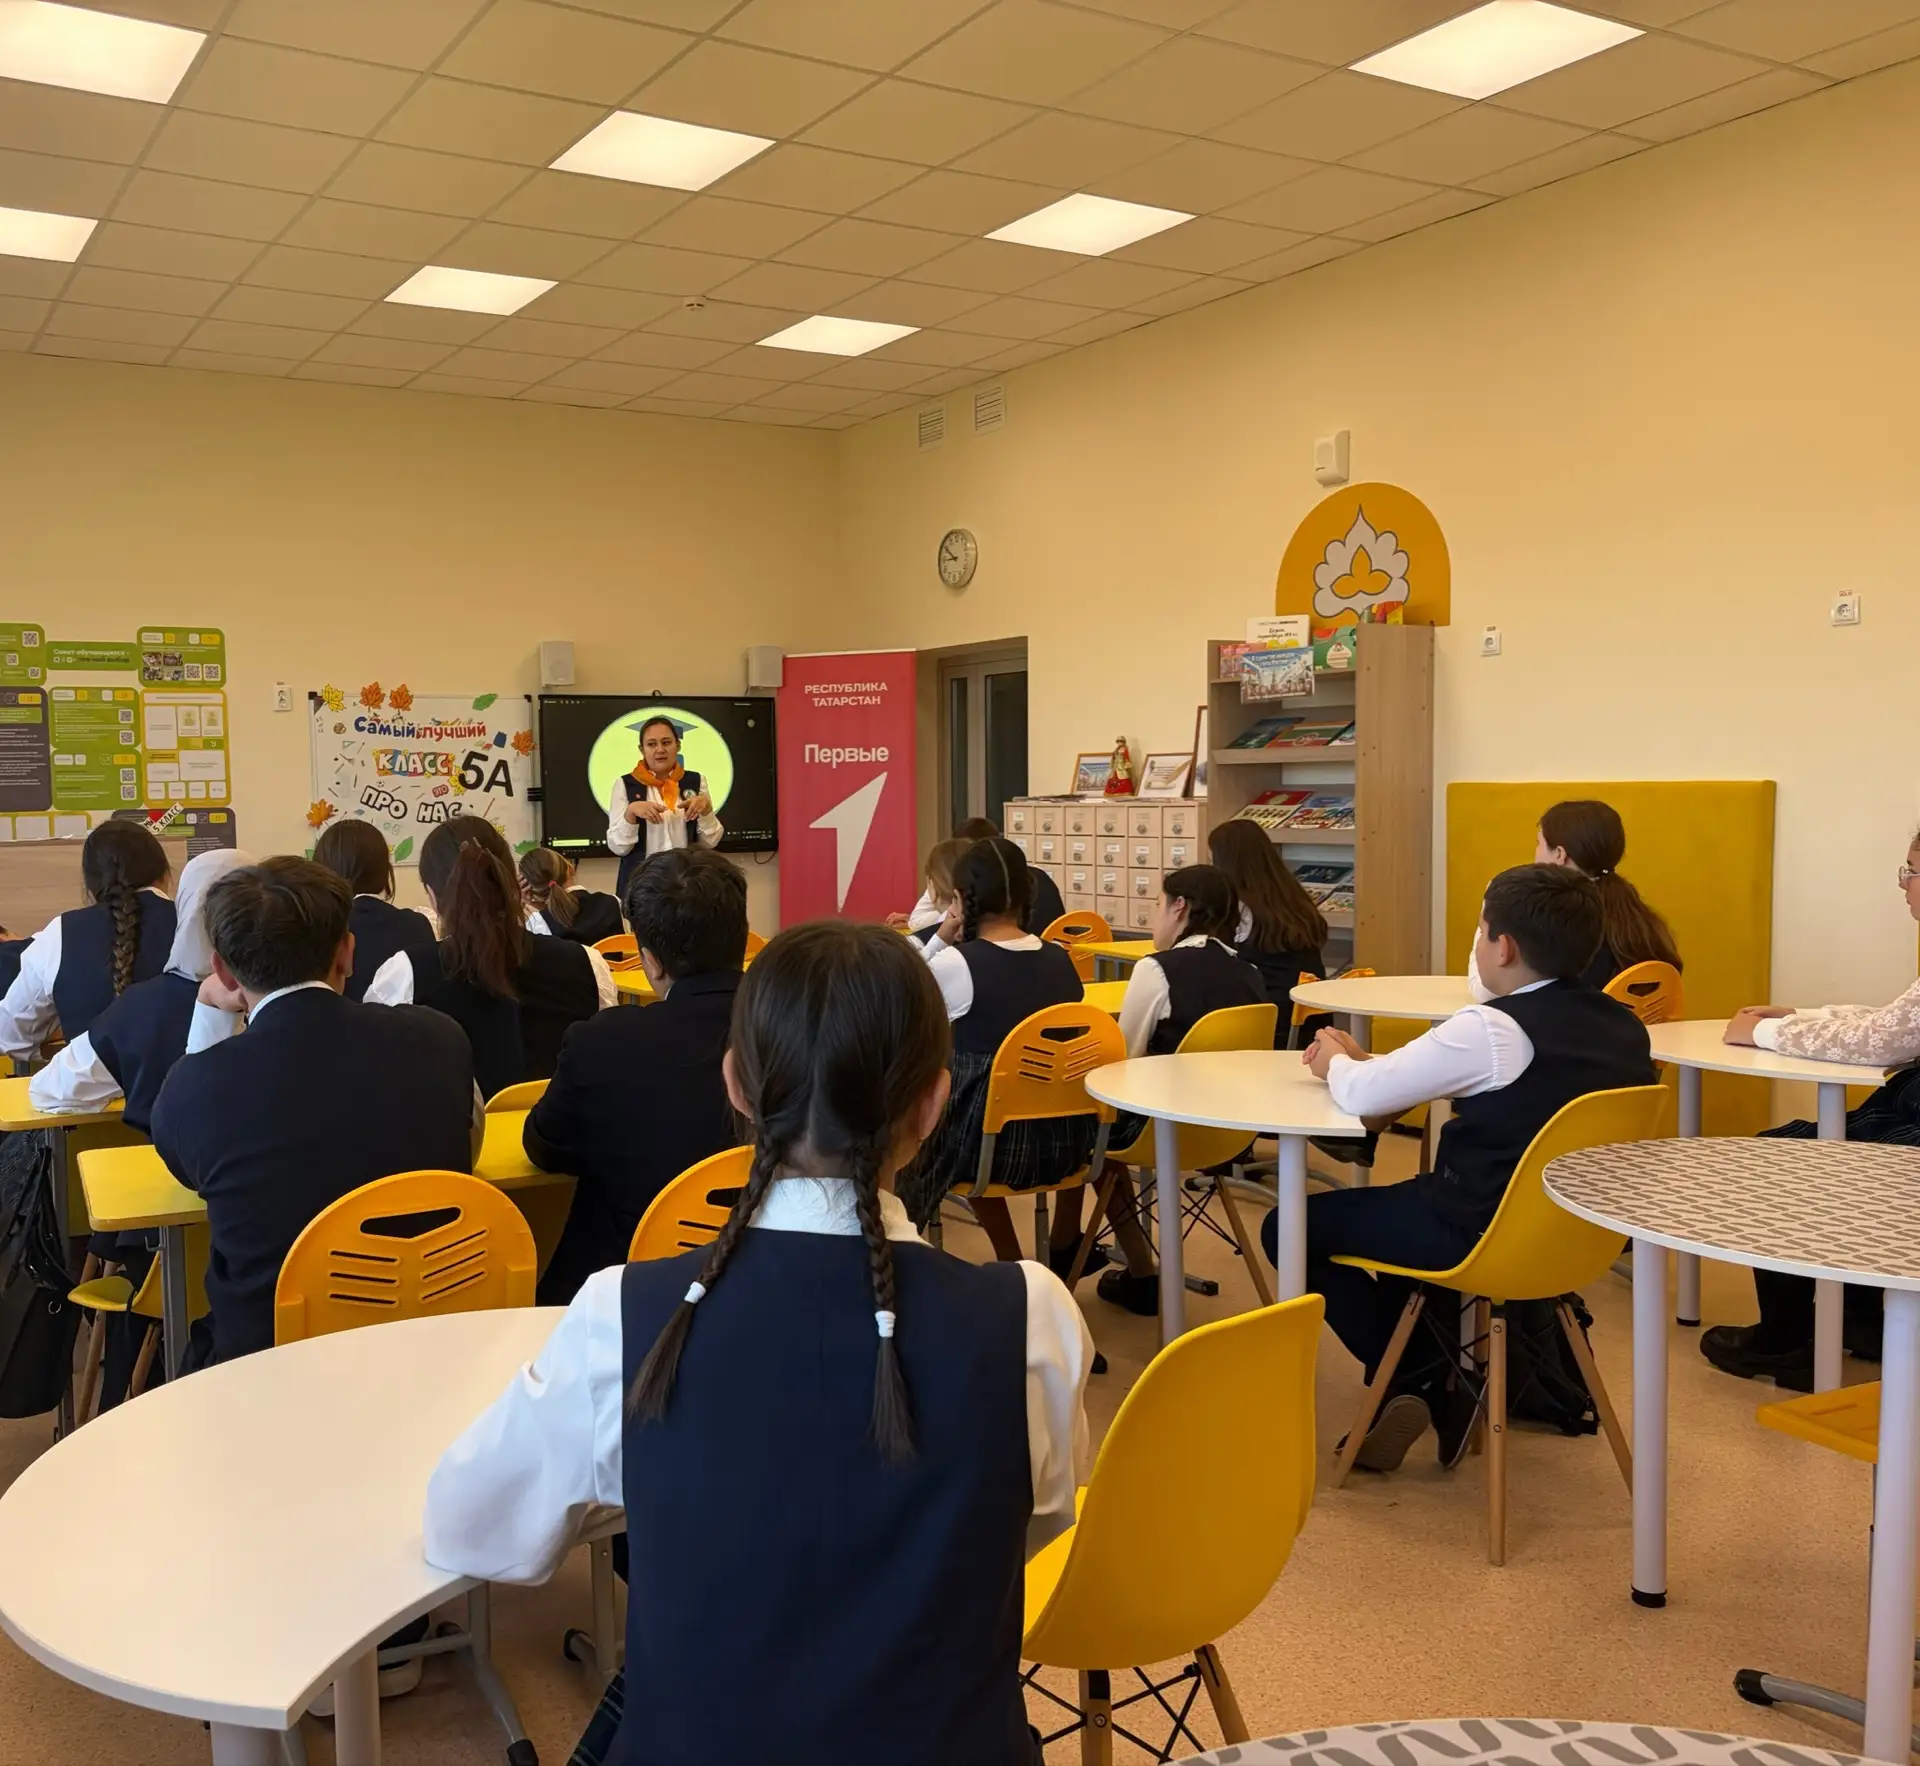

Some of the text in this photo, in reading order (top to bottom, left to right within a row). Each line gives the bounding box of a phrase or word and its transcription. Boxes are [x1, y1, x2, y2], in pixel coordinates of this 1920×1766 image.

[804, 682, 888, 694] РЕСПУБЛИКА
[812, 696, 881, 707] ТАТАРСТАН
[354, 716, 487, 742] Самый лучший
[804, 744, 889, 769] Первые
[378, 750, 514, 798] КЛАСС 5А
[360, 785, 408, 819] ПРО
[158, 804, 181, 827] КЛАСС
